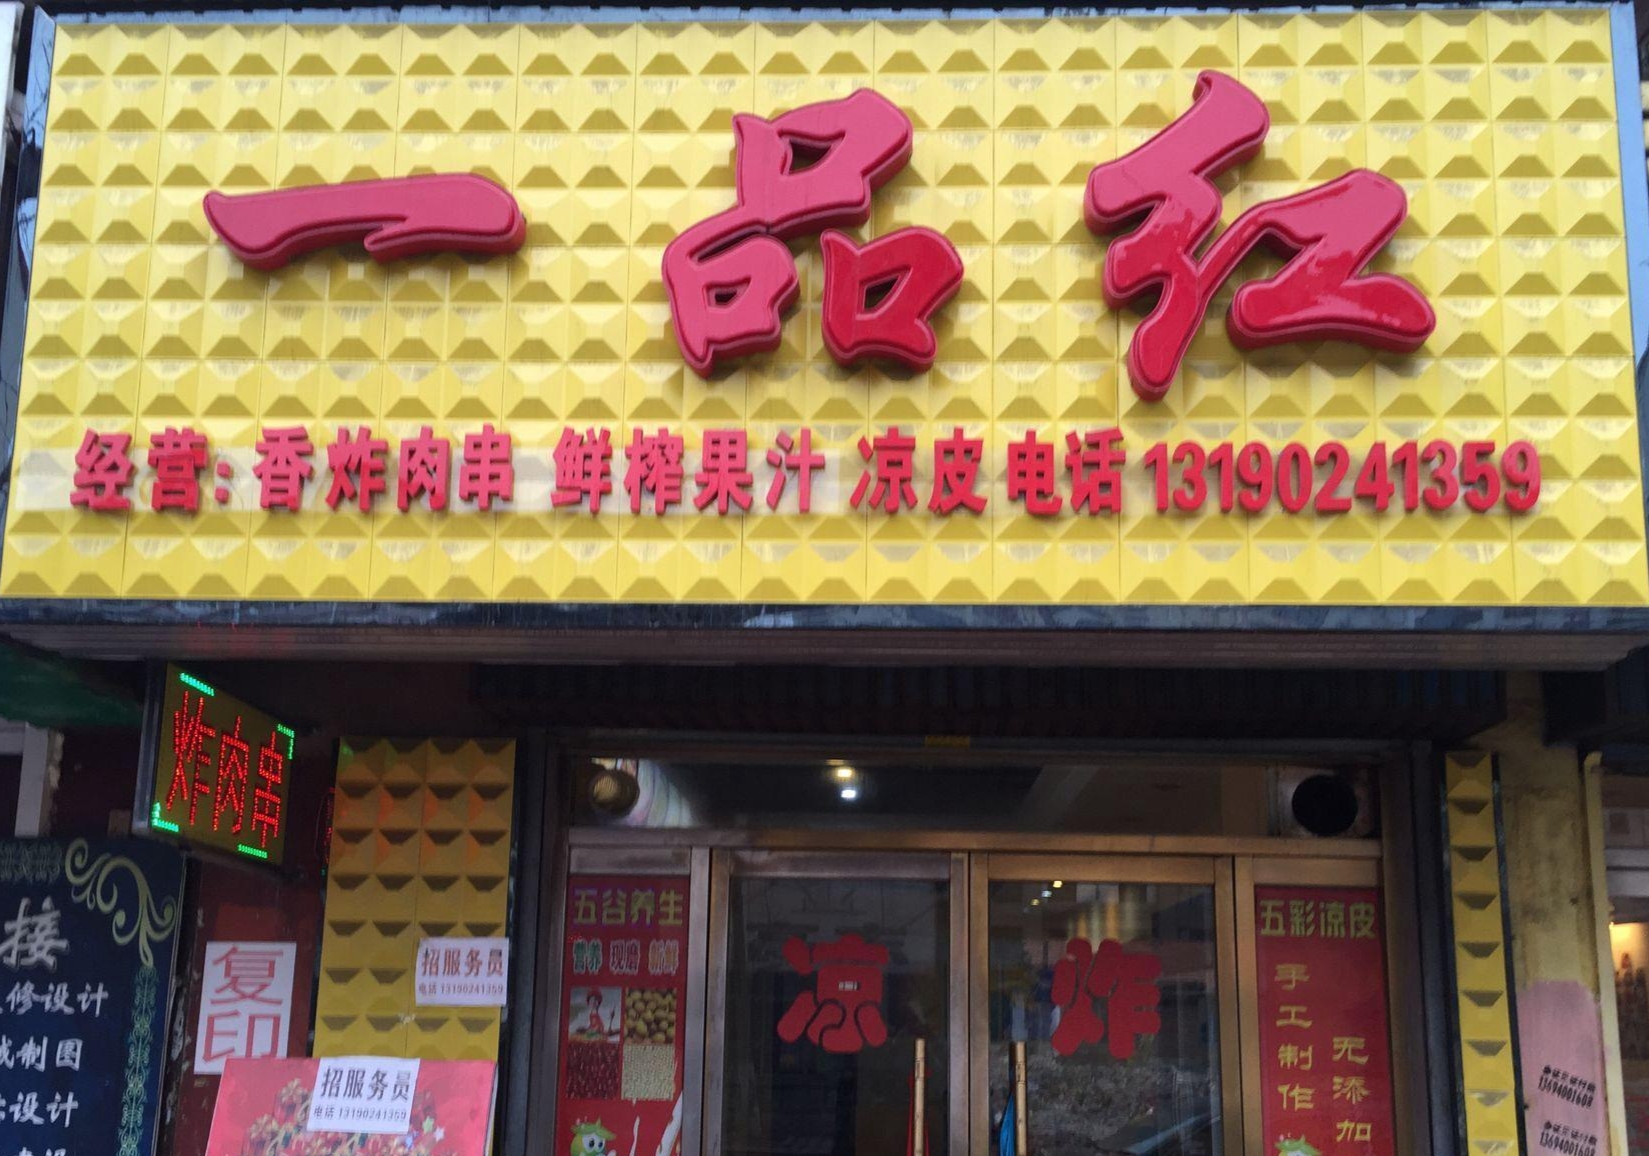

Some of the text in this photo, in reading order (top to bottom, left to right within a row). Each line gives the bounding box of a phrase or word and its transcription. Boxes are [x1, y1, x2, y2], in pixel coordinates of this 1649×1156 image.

[203, 69, 1436, 402] 一品红
[551, 427, 826, 516] 鲜榨果汁
[850, 427, 987, 515] 凉皮
[1006, 427, 1126, 515] 电话
[1143, 440, 1541, 513] 13190241359
[166, 690, 283, 848] 炸肉串
[573, 887, 684, 926] 五谷养生
[1259, 899, 1377, 939] 五彩凉皮
[0, 979, 109, 1018] 修设计
[203, 945, 284, 1063] 复印
[421, 946, 504, 978] 招服务员
[1052, 938, 1162, 1059] 炸
[1274, 963, 1316, 1112] 手工制作
[0, 1090, 79, 1128] 设计
[320, 1064, 412, 1102] 招服务员
[1332, 1036, 1371, 1143] 无添加
